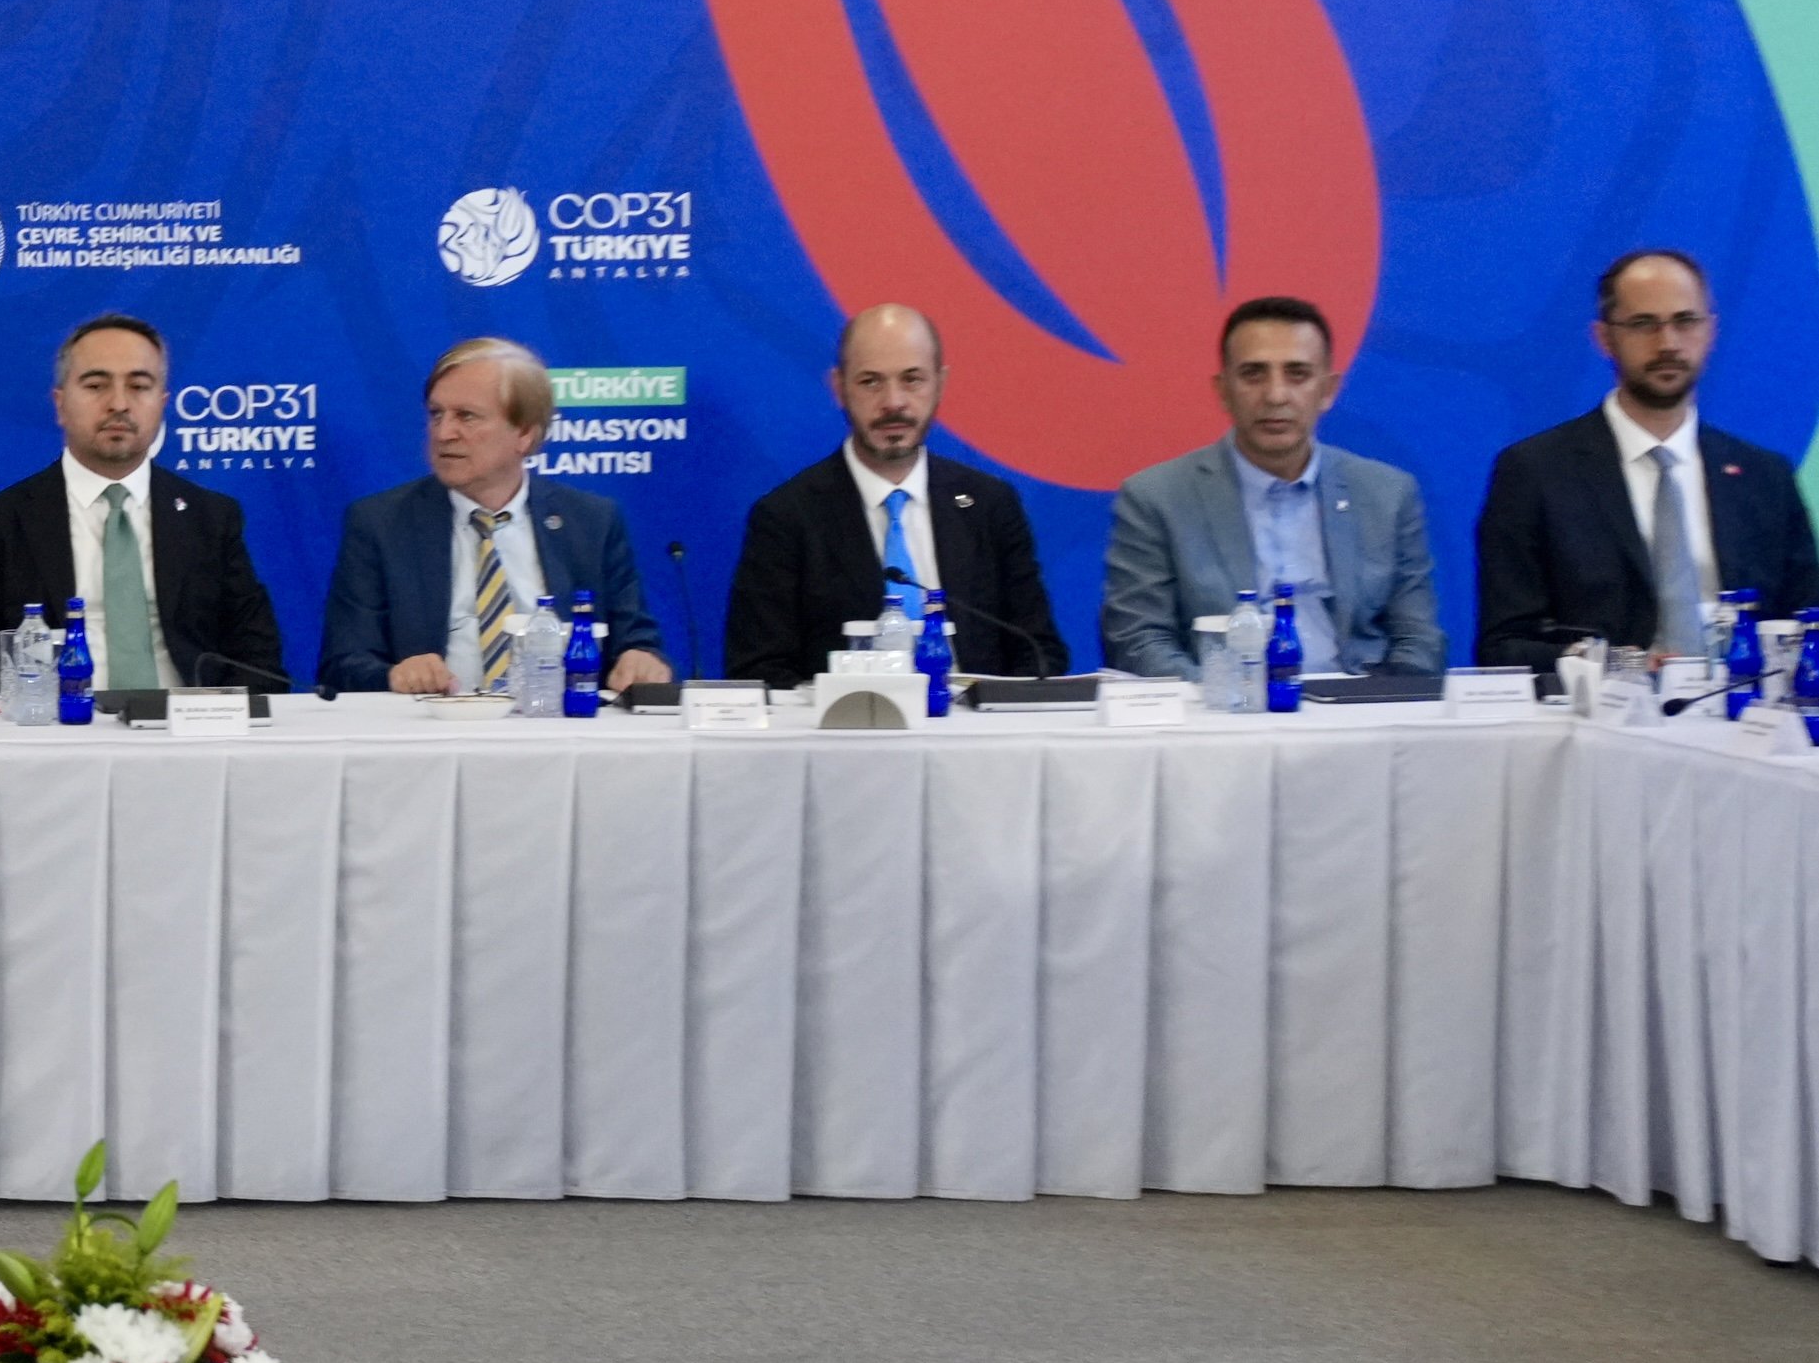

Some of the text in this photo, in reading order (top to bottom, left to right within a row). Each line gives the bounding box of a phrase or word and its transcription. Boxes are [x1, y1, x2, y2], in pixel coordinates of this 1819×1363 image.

[16, 198, 221, 222] TÜRKİYE CUMHURİYETİ
[549, 192, 690, 229] COP31
[17, 223, 222, 250] ÇEVRE, ŞEHİRCİLİK VE
[17, 244, 300, 271] İKLİM DEĞİŞİKLİĞİ BAKANLIĞI
[549, 264, 690, 278] ANTALYA
[550, 370, 676, 399] TÜRKİYE
[176, 384, 316, 420] COP31
[545, 414, 687, 442] İNASYON
[176, 458, 315, 470] ANTALYA
[522, 451, 652, 475] PLANTISI
